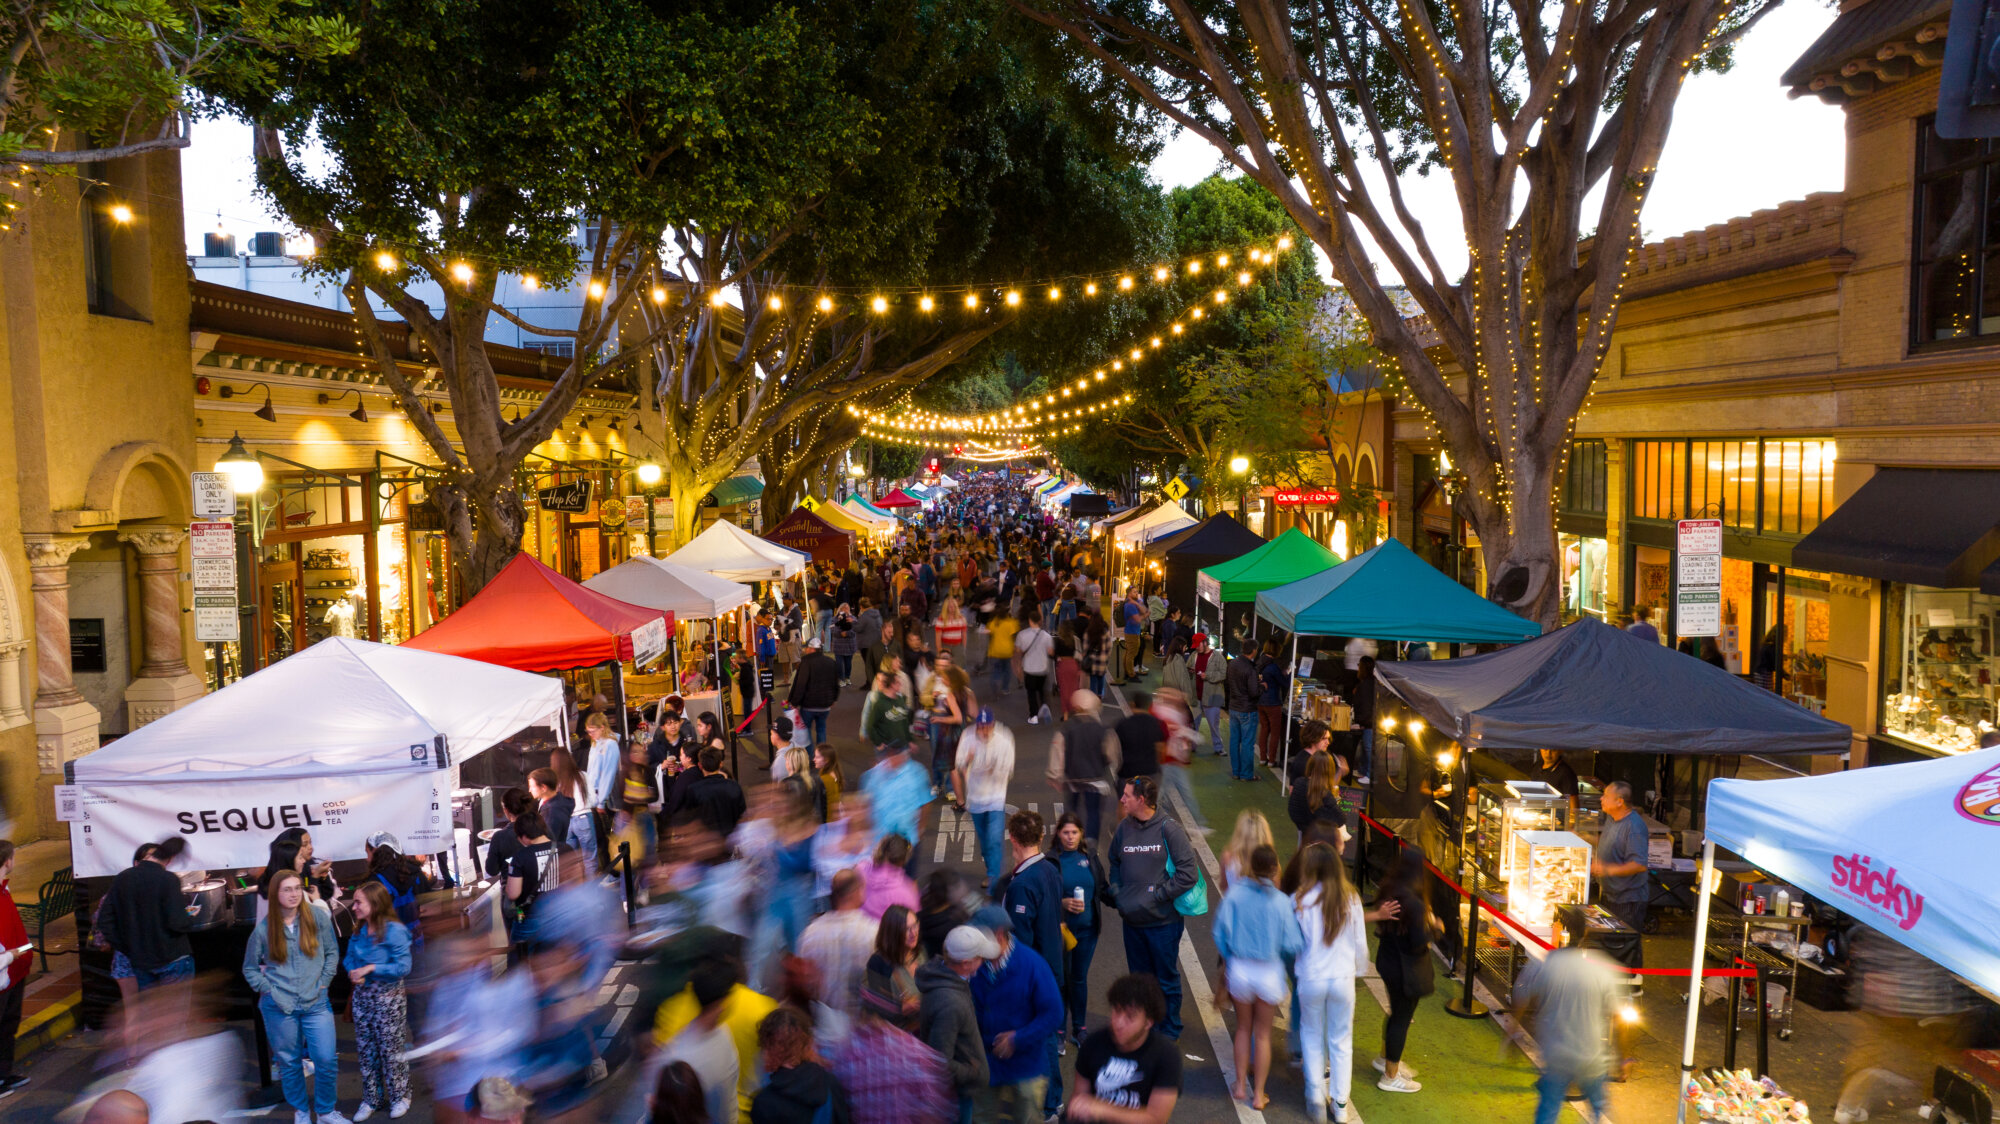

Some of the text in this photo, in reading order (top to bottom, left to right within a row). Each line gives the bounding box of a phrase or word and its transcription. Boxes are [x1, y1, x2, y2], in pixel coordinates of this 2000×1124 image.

[541, 489, 587, 509] Hep Kat
[322, 800, 346, 808] COLD
[324, 808, 349, 816] BREW
[176, 804, 322, 835] SEQUEL
[1123, 844, 1161, 853] carhartt
[1831, 853, 1925, 931] sticky
